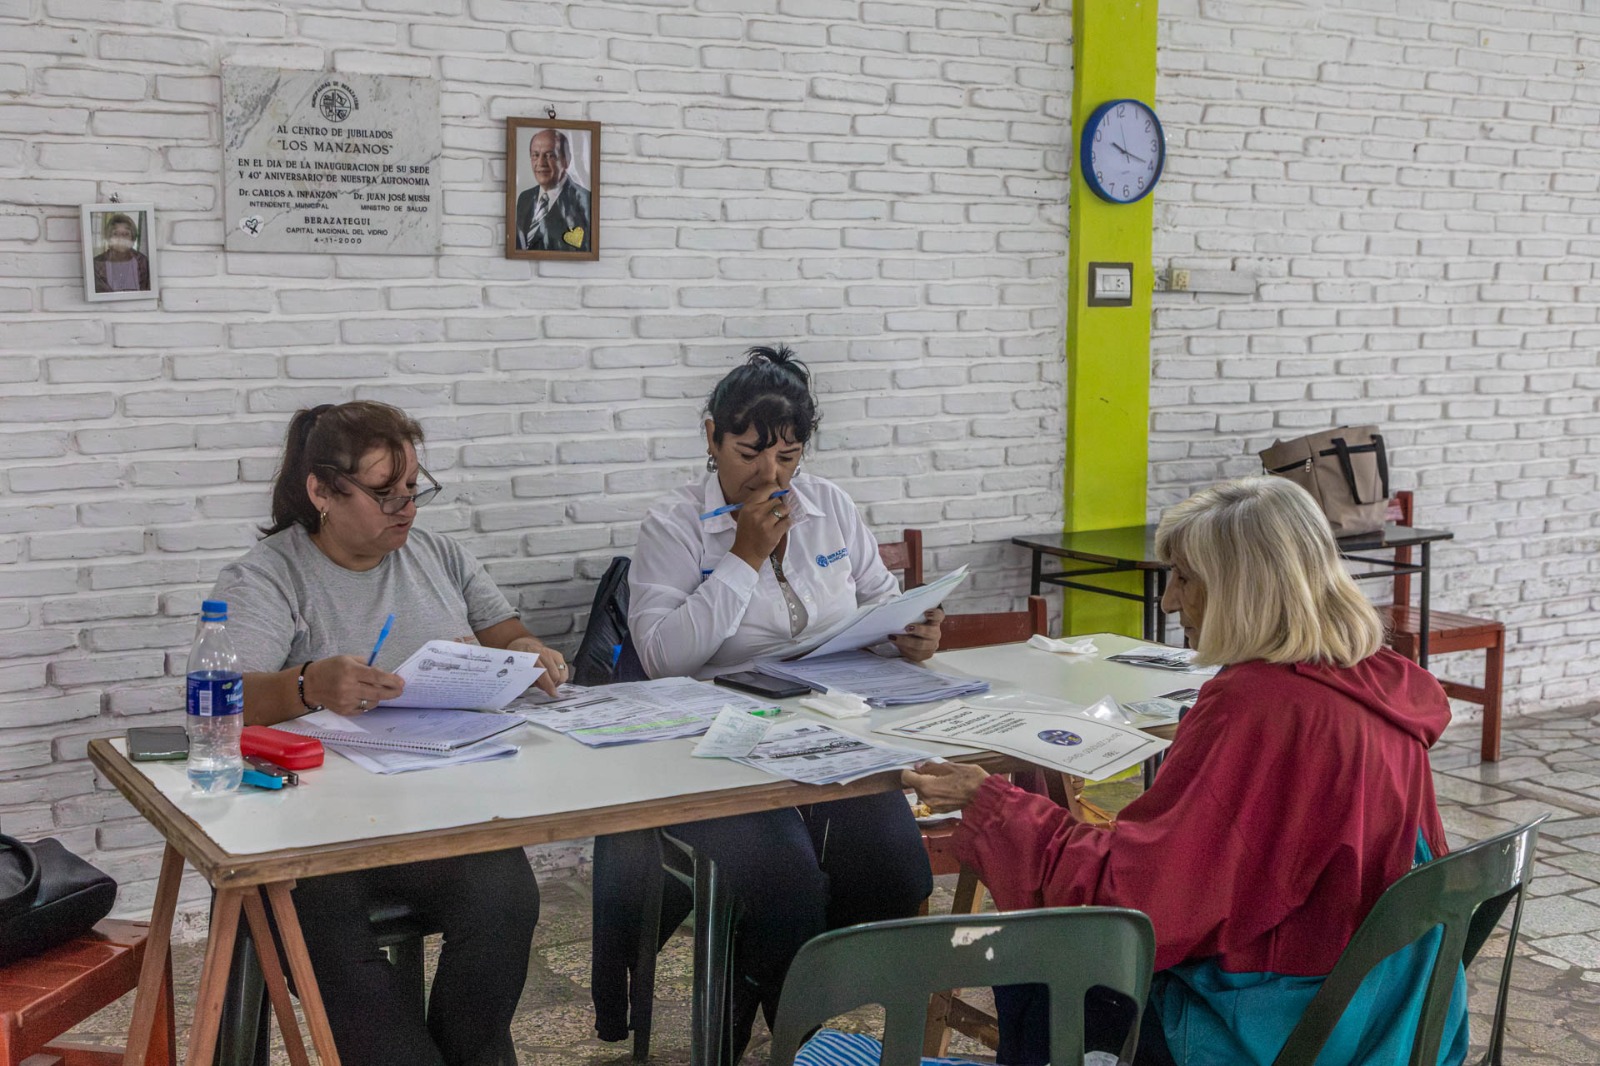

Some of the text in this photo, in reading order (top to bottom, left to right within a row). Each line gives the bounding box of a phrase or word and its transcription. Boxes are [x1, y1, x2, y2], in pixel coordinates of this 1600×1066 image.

[1116, 105, 1126, 118] 12
[1135, 106, 1138, 119] 1
[1102, 115, 1110, 127] 11
[1145, 120, 1151, 133] 2
[277, 125, 393, 139] AL CENTRO DE JUBILADOS
[1095, 130, 1102, 142] 0
[1150, 140, 1157, 152] 3
[238, 158, 250, 166] EN
[253, 159, 263, 167] EL
[267, 160, 282, 168] DIA
[286, 160, 297, 168] DE
[300, 161, 311, 169] LA
[314, 162, 379, 172] INAUGURACION
[383, 164, 393, 172] DE
[410, 166, 430, 174] SEDE
[1148, 160, 1154, 171] 4
[239, 170, 244, 179] Y
[265, 172, 323, 182] ANIVERSARIO
[326, 174, 337, 182] DE
[341, 175, 377, 184] NUESTRA
[381, 177, 430, 186] AUTONOMIA
[1096, 171, 1103, 184] 8
[1137, 177, 1144, 190] 5
[252, 189, 285, 197] CARLOS
[1109, 183, 1115, 195] 7
[1123, 185, 1130, 198] 6
[366, 193, 385, 201] JUAN
[388, 193, 406, 202] JOSÉ
[304, 216, 370, 225] BERAZATEGUI
